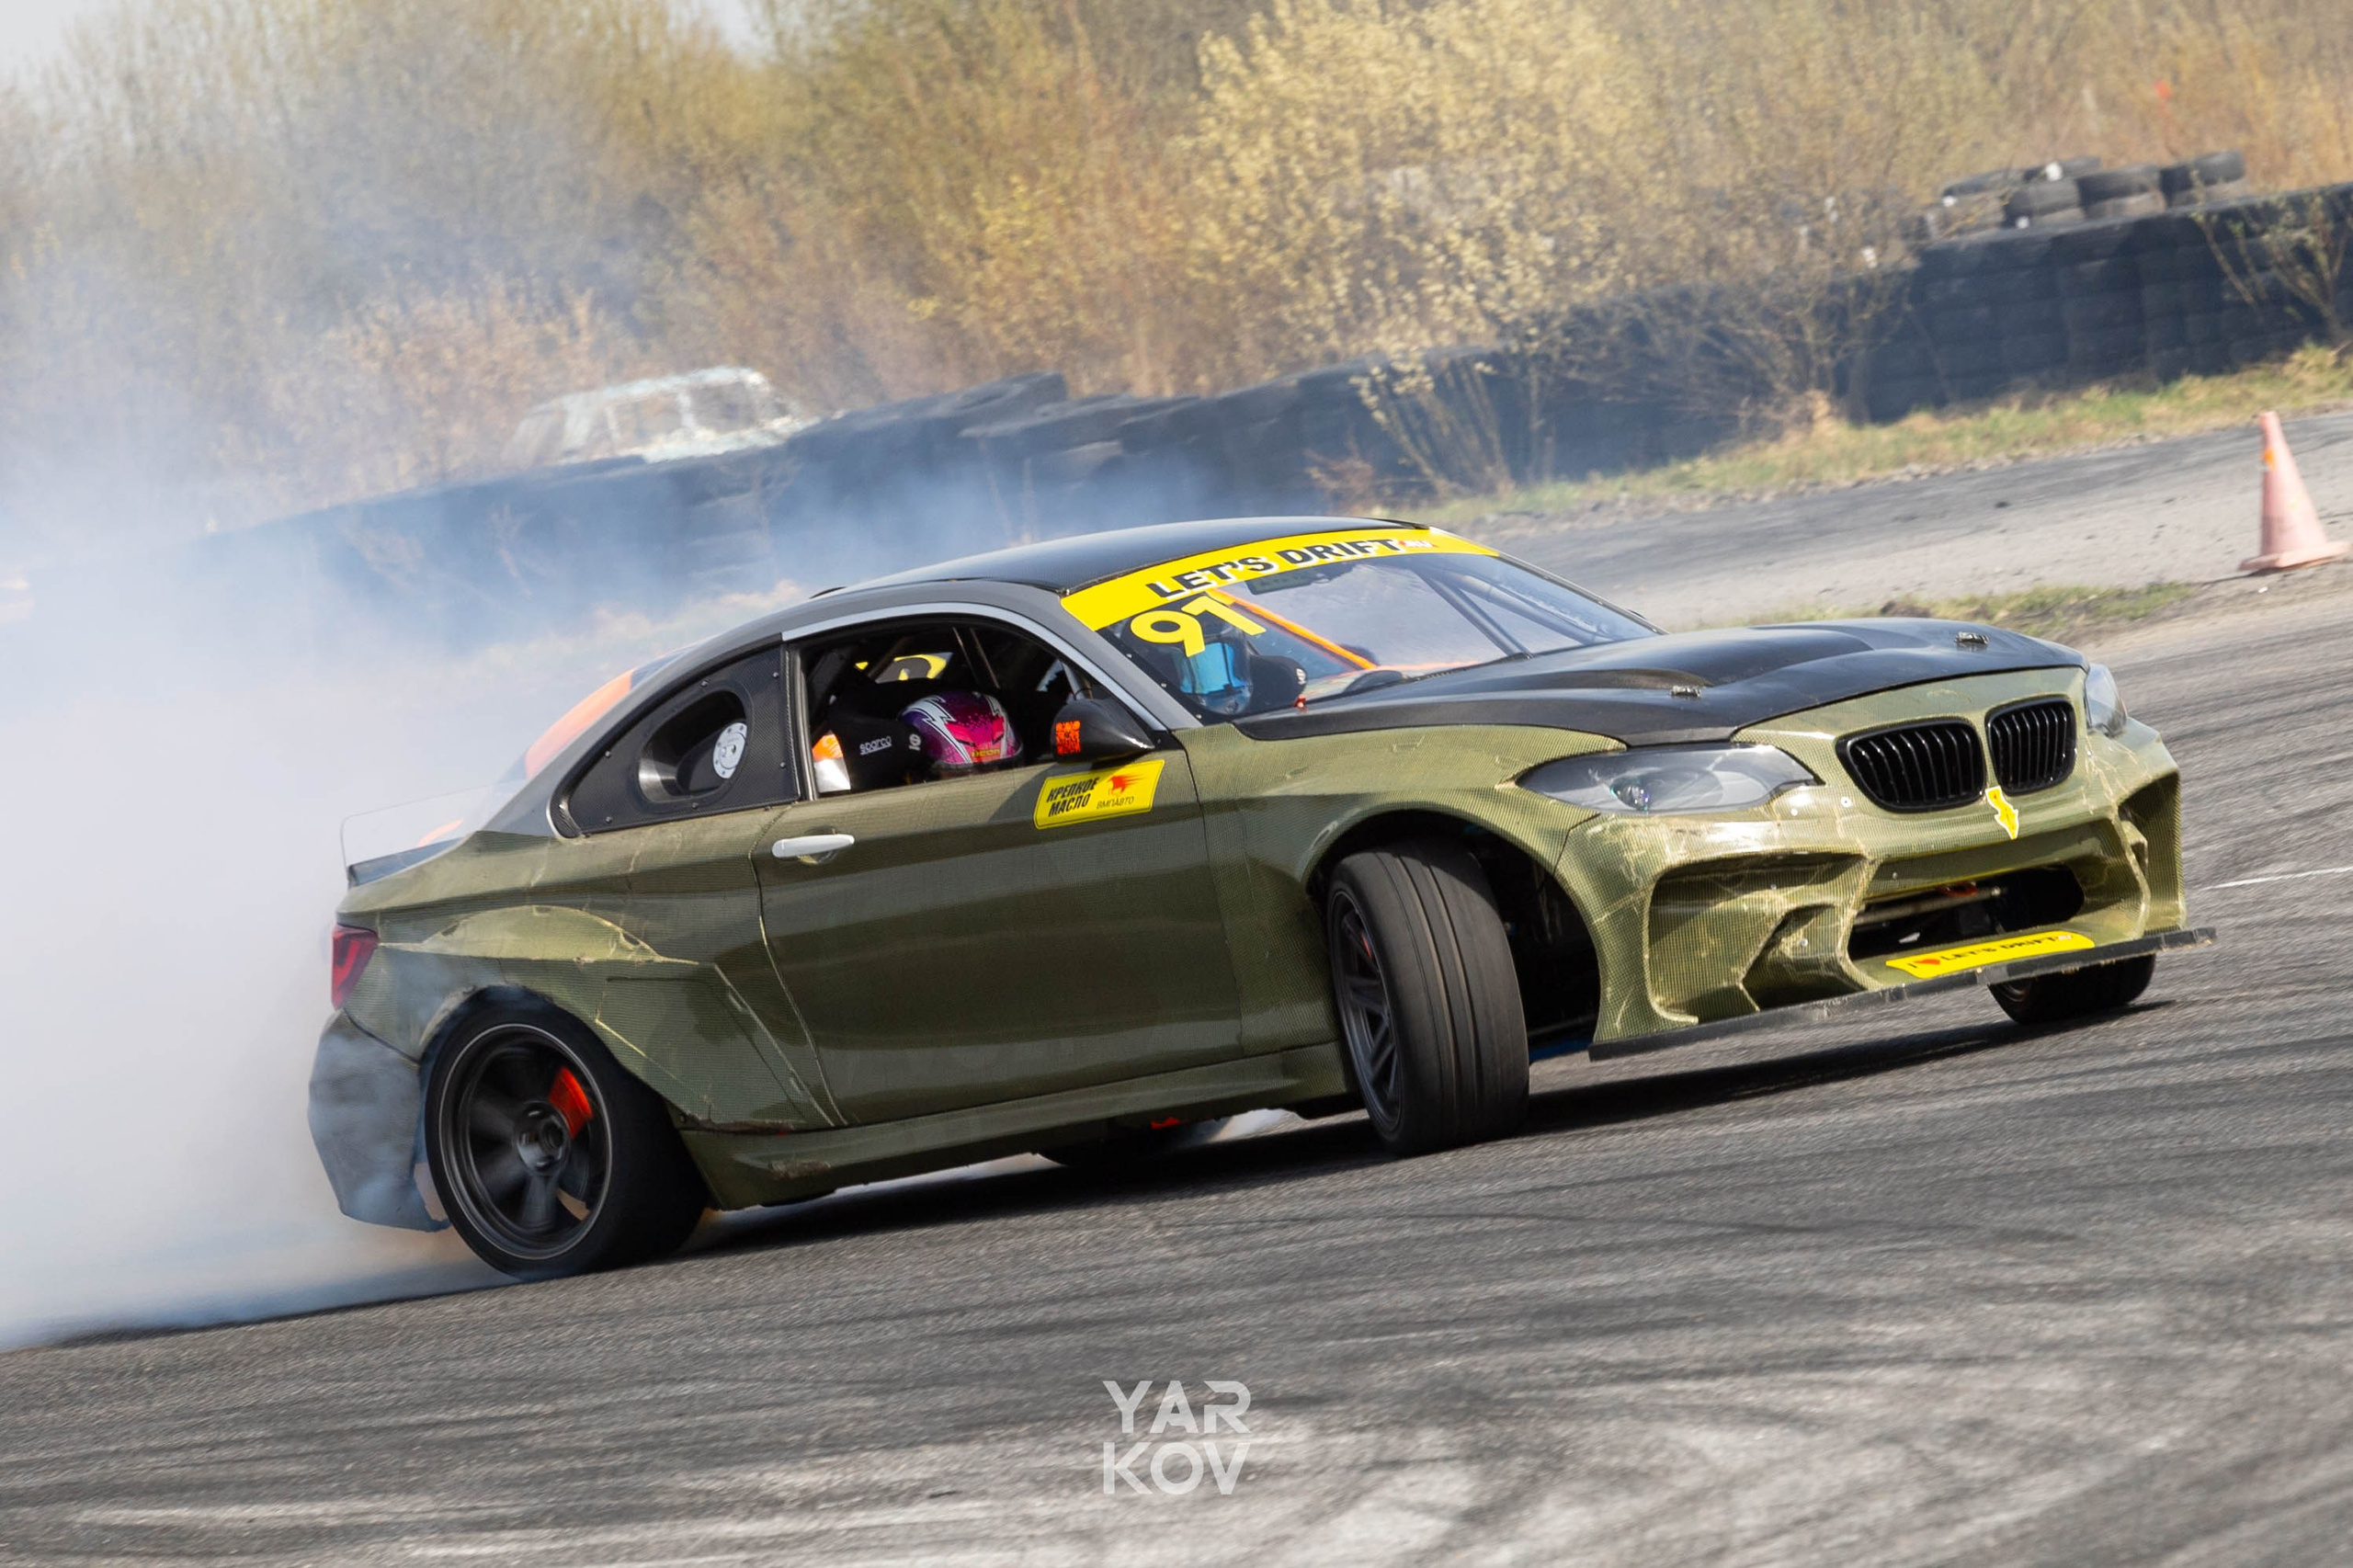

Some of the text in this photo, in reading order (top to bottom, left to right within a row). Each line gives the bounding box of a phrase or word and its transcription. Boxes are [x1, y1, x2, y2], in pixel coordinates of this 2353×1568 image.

[1145, 539, 1403, 599] LET'S DRIFT
[1130, 595, 1267, 658] 91
[1046, 777, 1100, 803] КРЕПКОЕ
[1048, 793, 1091, 817] МАСЛО
